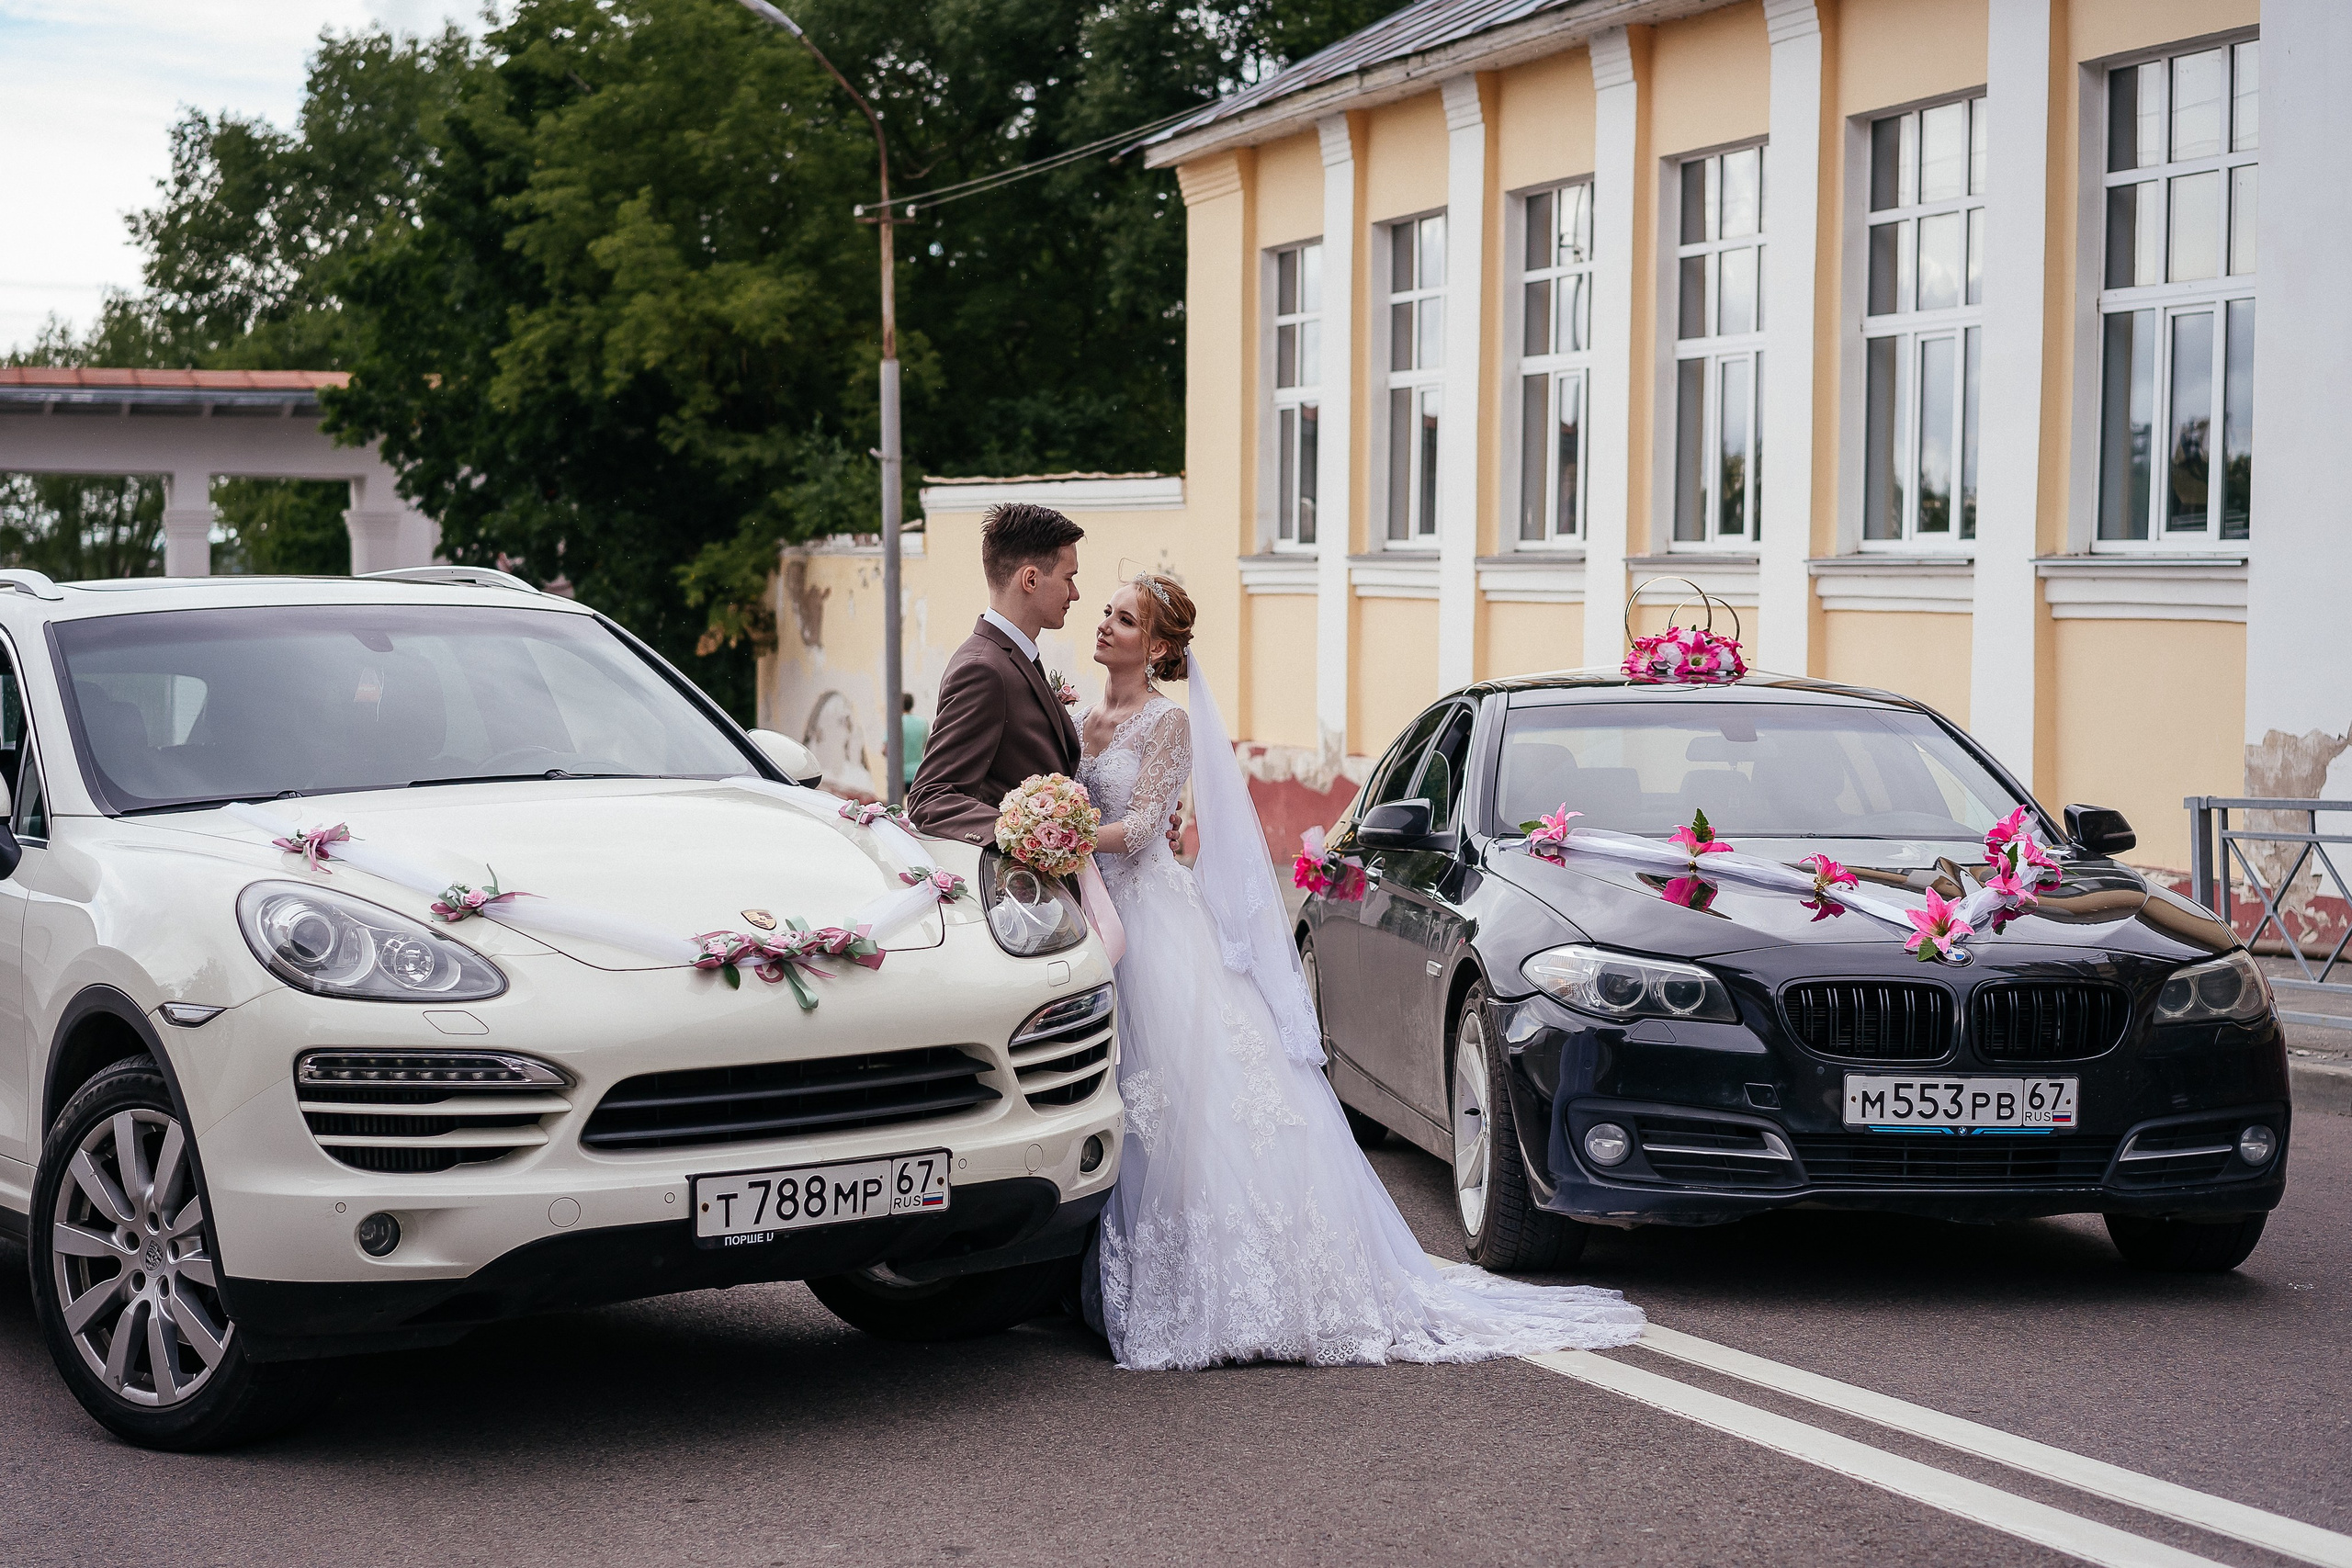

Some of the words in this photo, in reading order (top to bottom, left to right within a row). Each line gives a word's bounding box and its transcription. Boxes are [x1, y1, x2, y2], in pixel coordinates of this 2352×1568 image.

[1860, 1082, 2016, 1121] М553РВ
[2028, 1082, 2065, 1111] 67
[2025, 1111, 2052, 1122] RUS
[716, 1174, 883, 1228] Т788МР
[896, 1159, 934, 1194] 67
[893, 1195, 922, 1210] RUS
[724, 1233, 764, 1247] ПОРШЕ
